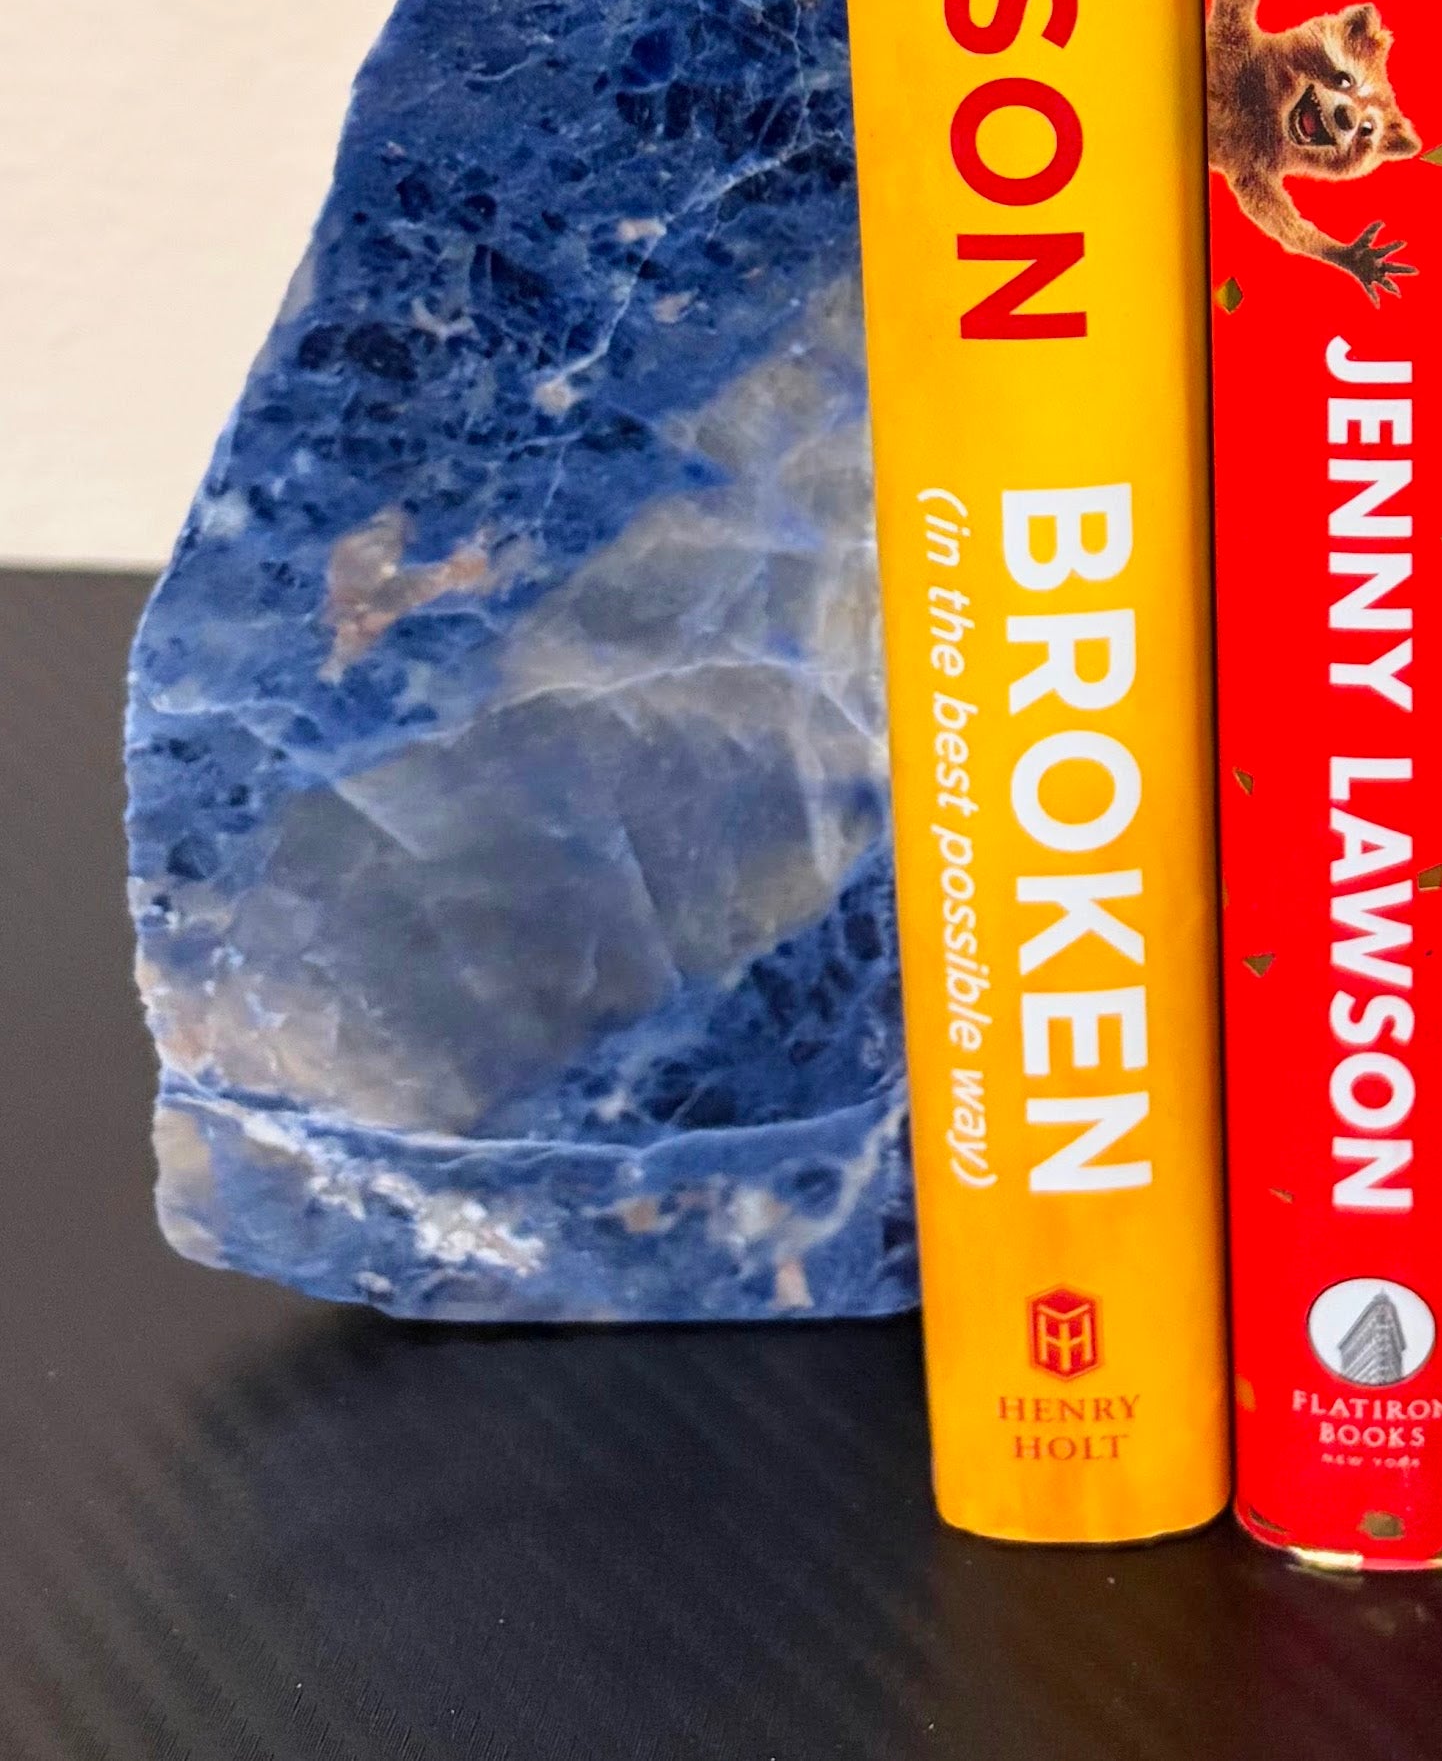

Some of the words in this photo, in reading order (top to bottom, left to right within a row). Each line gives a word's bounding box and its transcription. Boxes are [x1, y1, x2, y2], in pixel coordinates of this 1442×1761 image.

[917, 487, 969, 567] (in
[1324, 334, 1414, 712] JENNY
[927, 586, 976, 678] the
[931, 692, 978, 820] best
[1001, 481, 1154, 1194] BROKEN
[931, 822, 993, 1052] possible
[1328, 755, 1416, 1212] LAWSON
[946, 1067, 998, 1190] way)
[998, 1394, 1141, 1422] HENRY
[1013, 1433, 1131, 1460] HOLT
[1319, 1421, 1426, 1448] BOOKS
